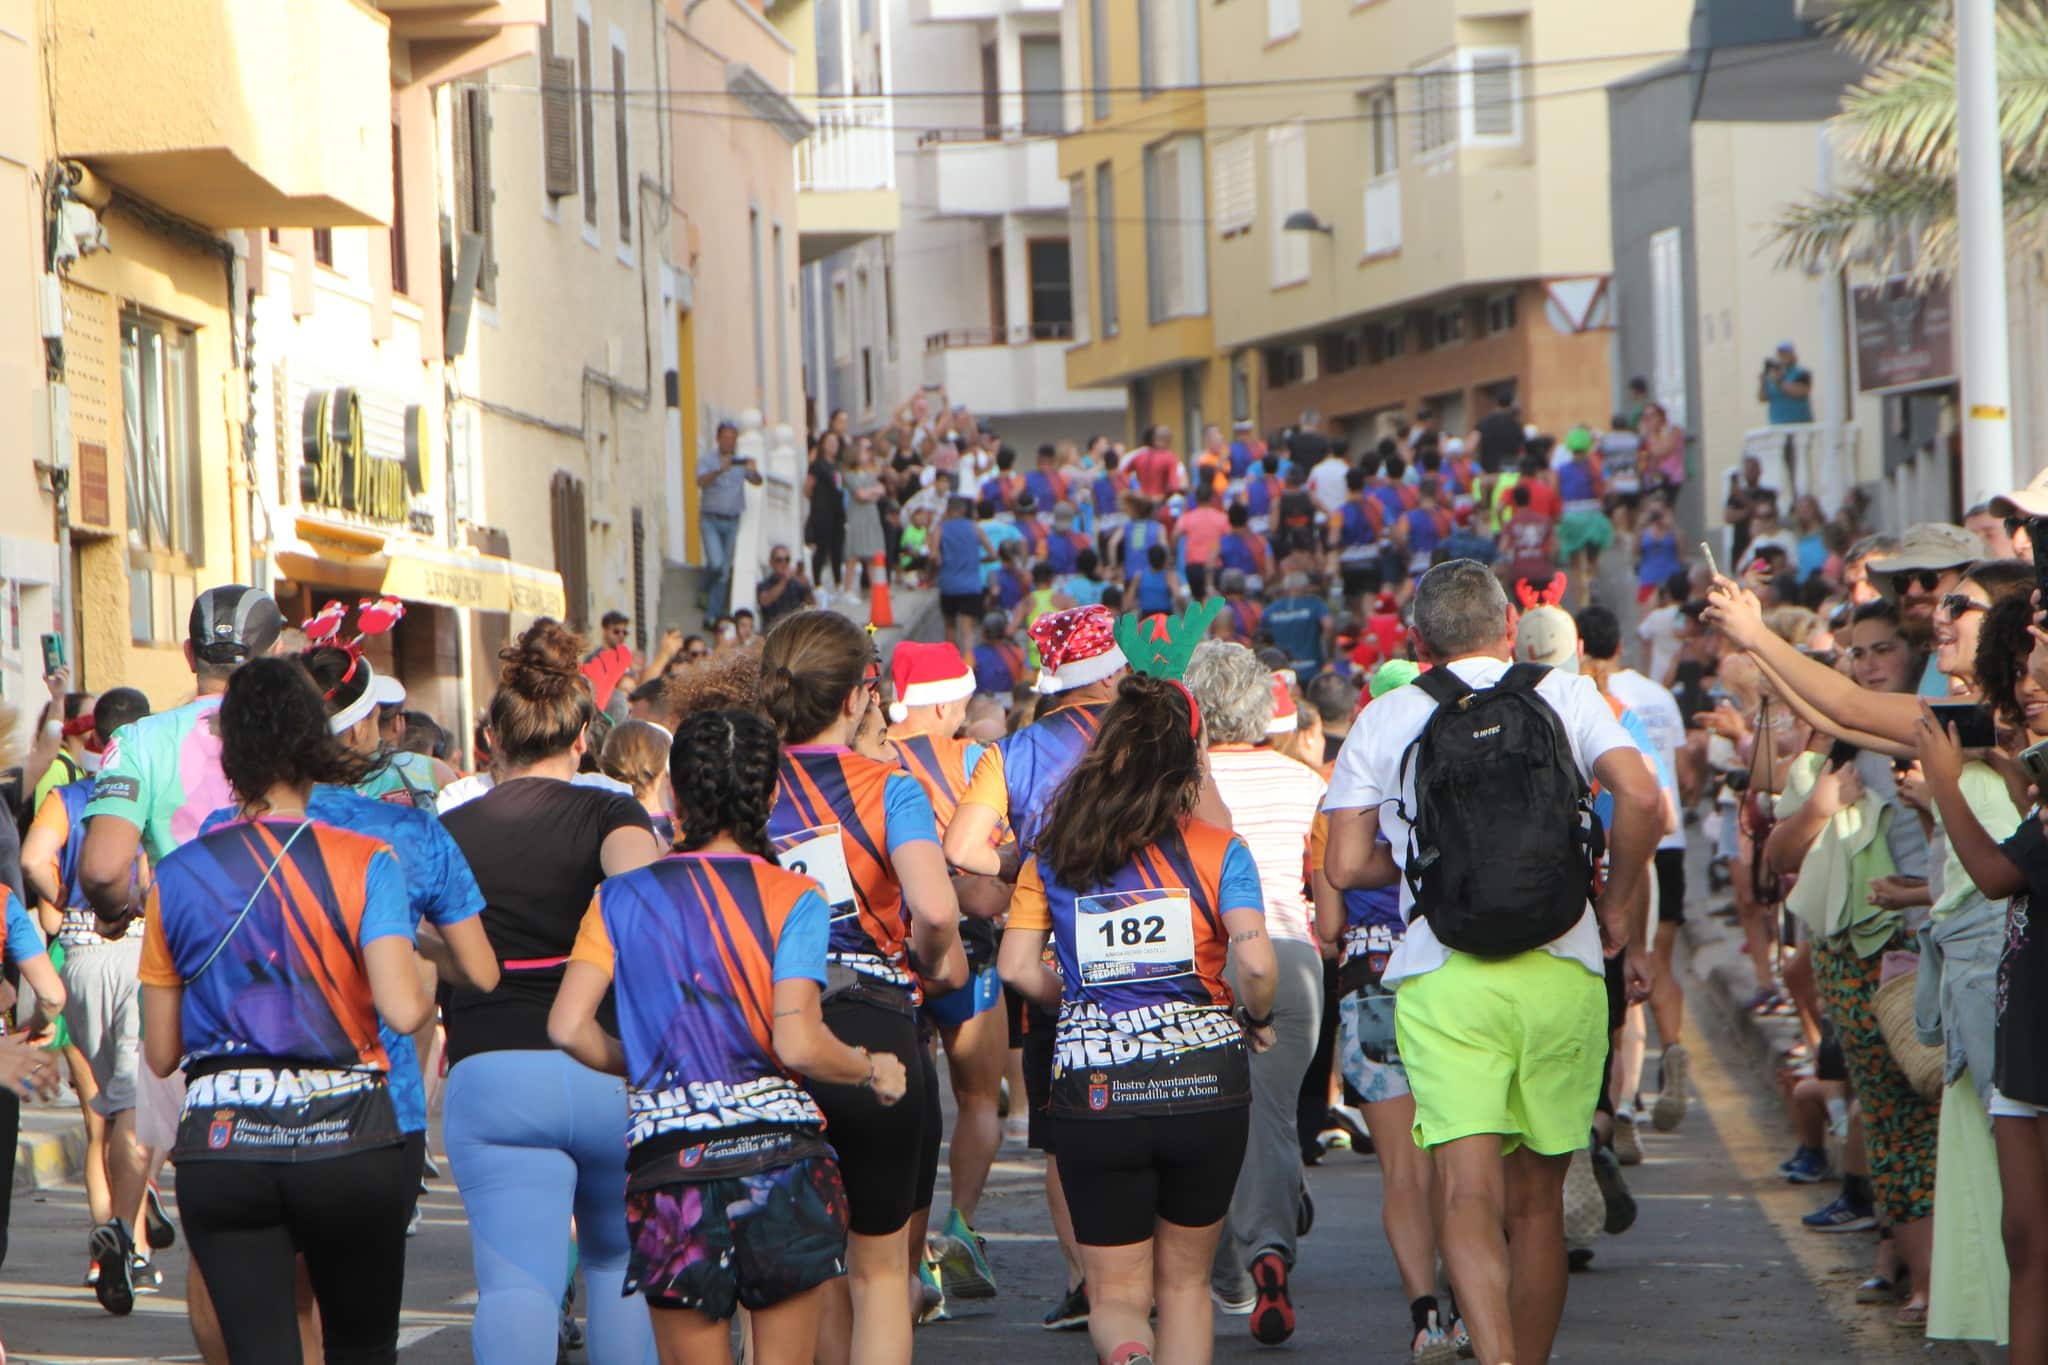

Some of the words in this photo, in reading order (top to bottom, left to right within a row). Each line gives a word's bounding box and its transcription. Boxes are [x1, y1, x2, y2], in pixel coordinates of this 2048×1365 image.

[1098, 915, 1167, 947] 182
[1112, 1079, 1145, 1090] Ilustre
[1147, 1073, 1218, 1089] Ayuntamiento
[1112, 1088, 1169, 1101] Granadilla
[1171, 1088, 1184, 1097] de
[1186, 1085, 1218, 1096] Abona
